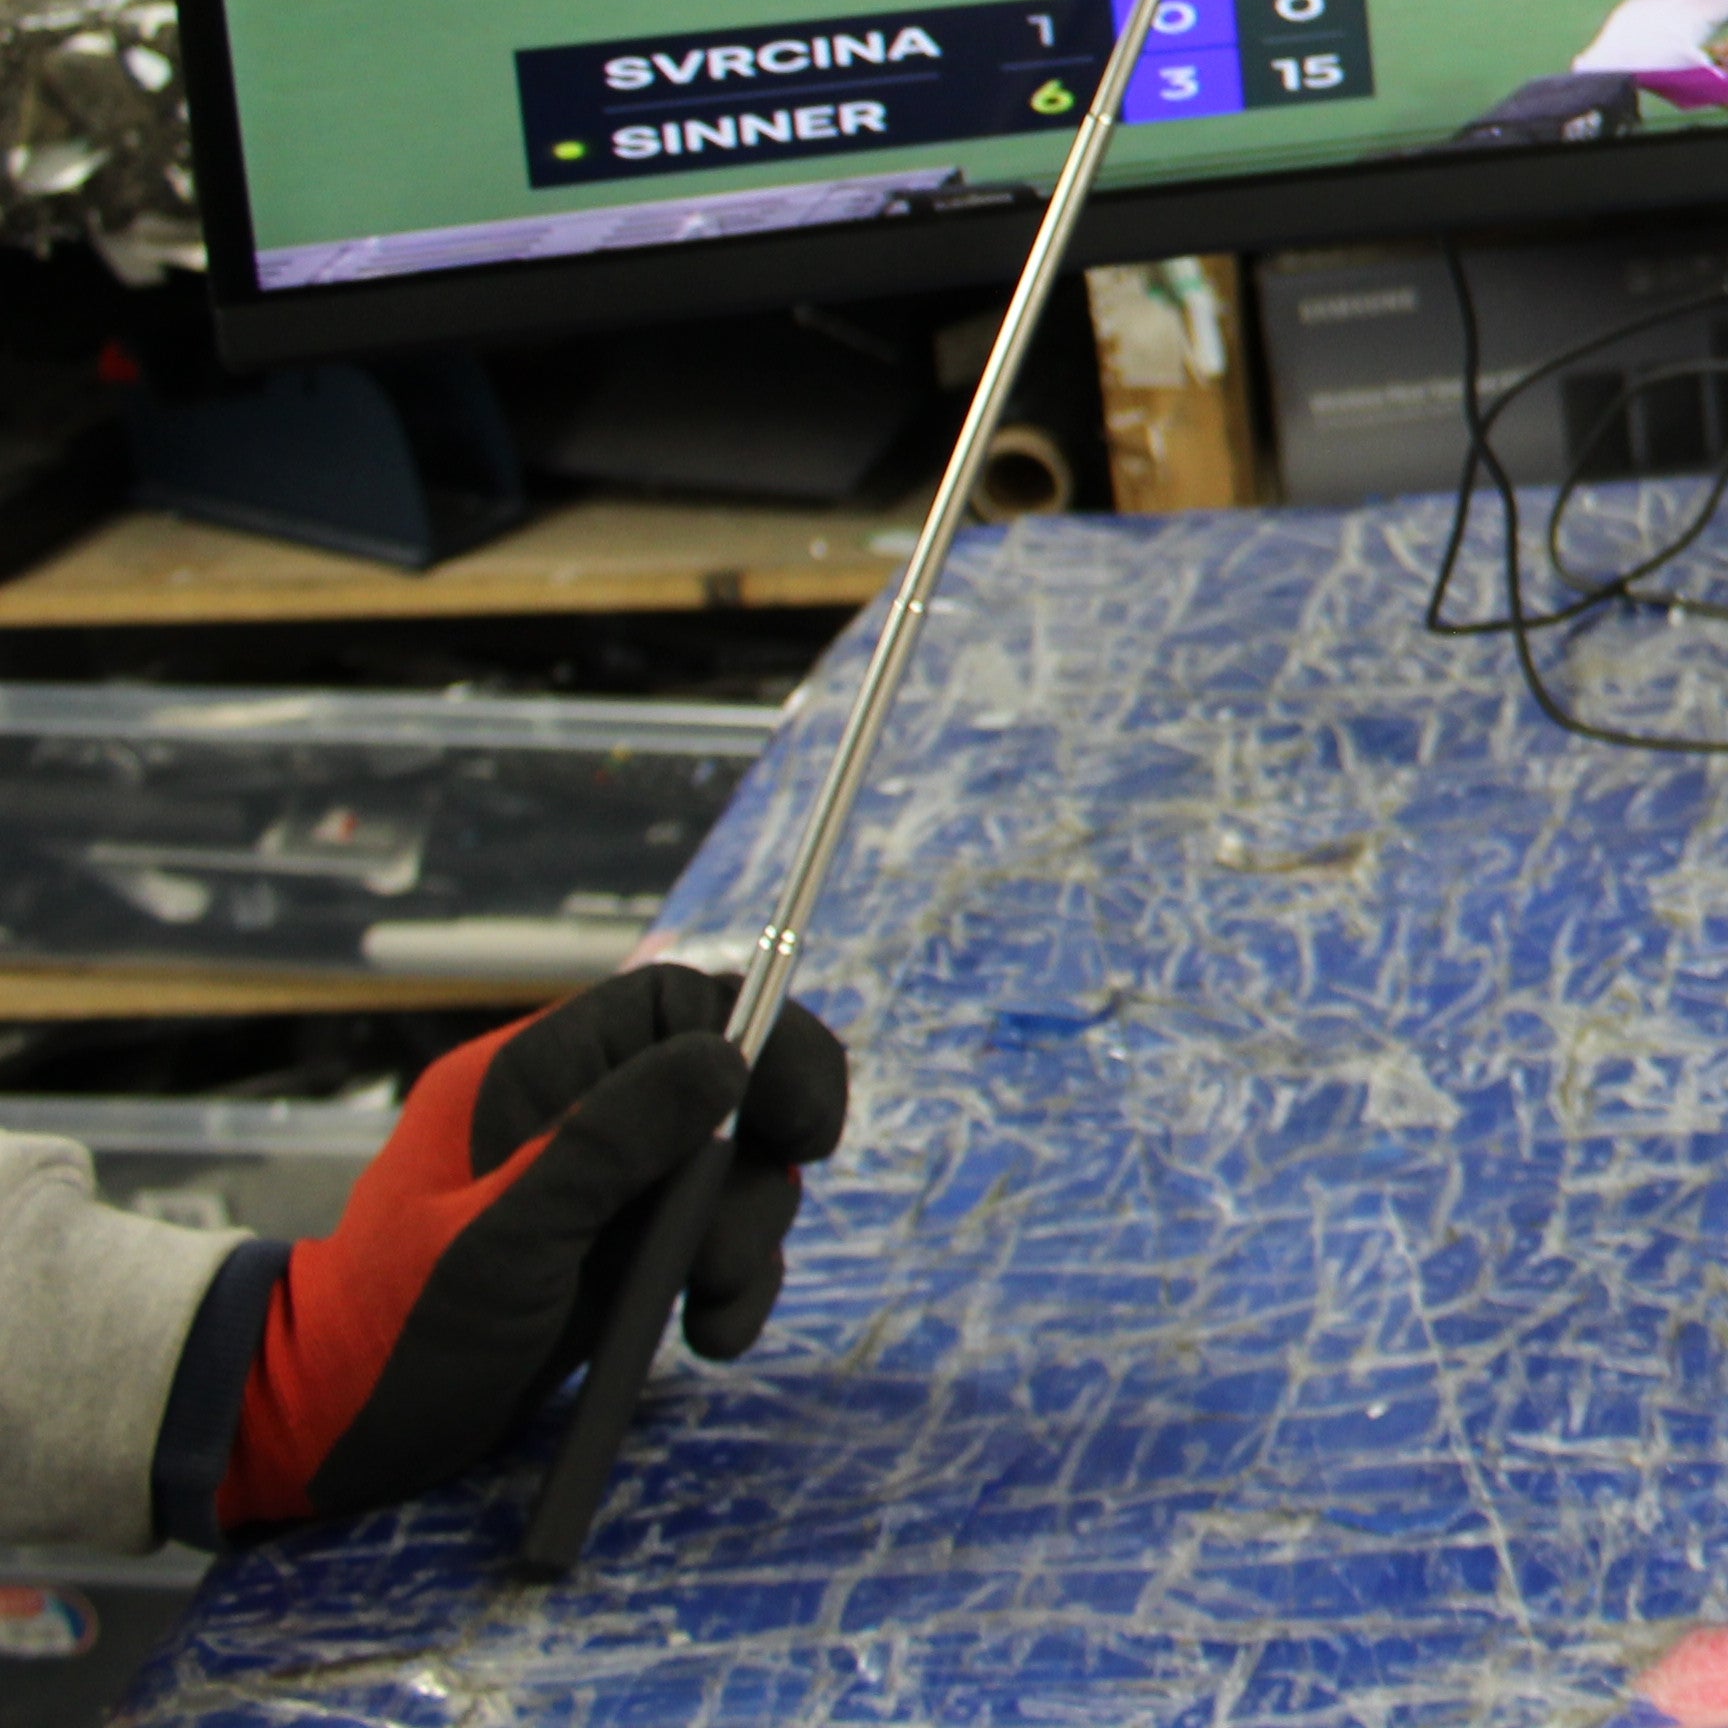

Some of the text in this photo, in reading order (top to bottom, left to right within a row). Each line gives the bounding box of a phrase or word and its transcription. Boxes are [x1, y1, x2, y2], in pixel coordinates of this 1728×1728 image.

[605, 26, 941, 91] SVRCINA
[1028, 13, 1055, 47] 1
[1152, 0, 1197, 35] 0
[611, 55, 1344, 162] SINNER 6 3 15
